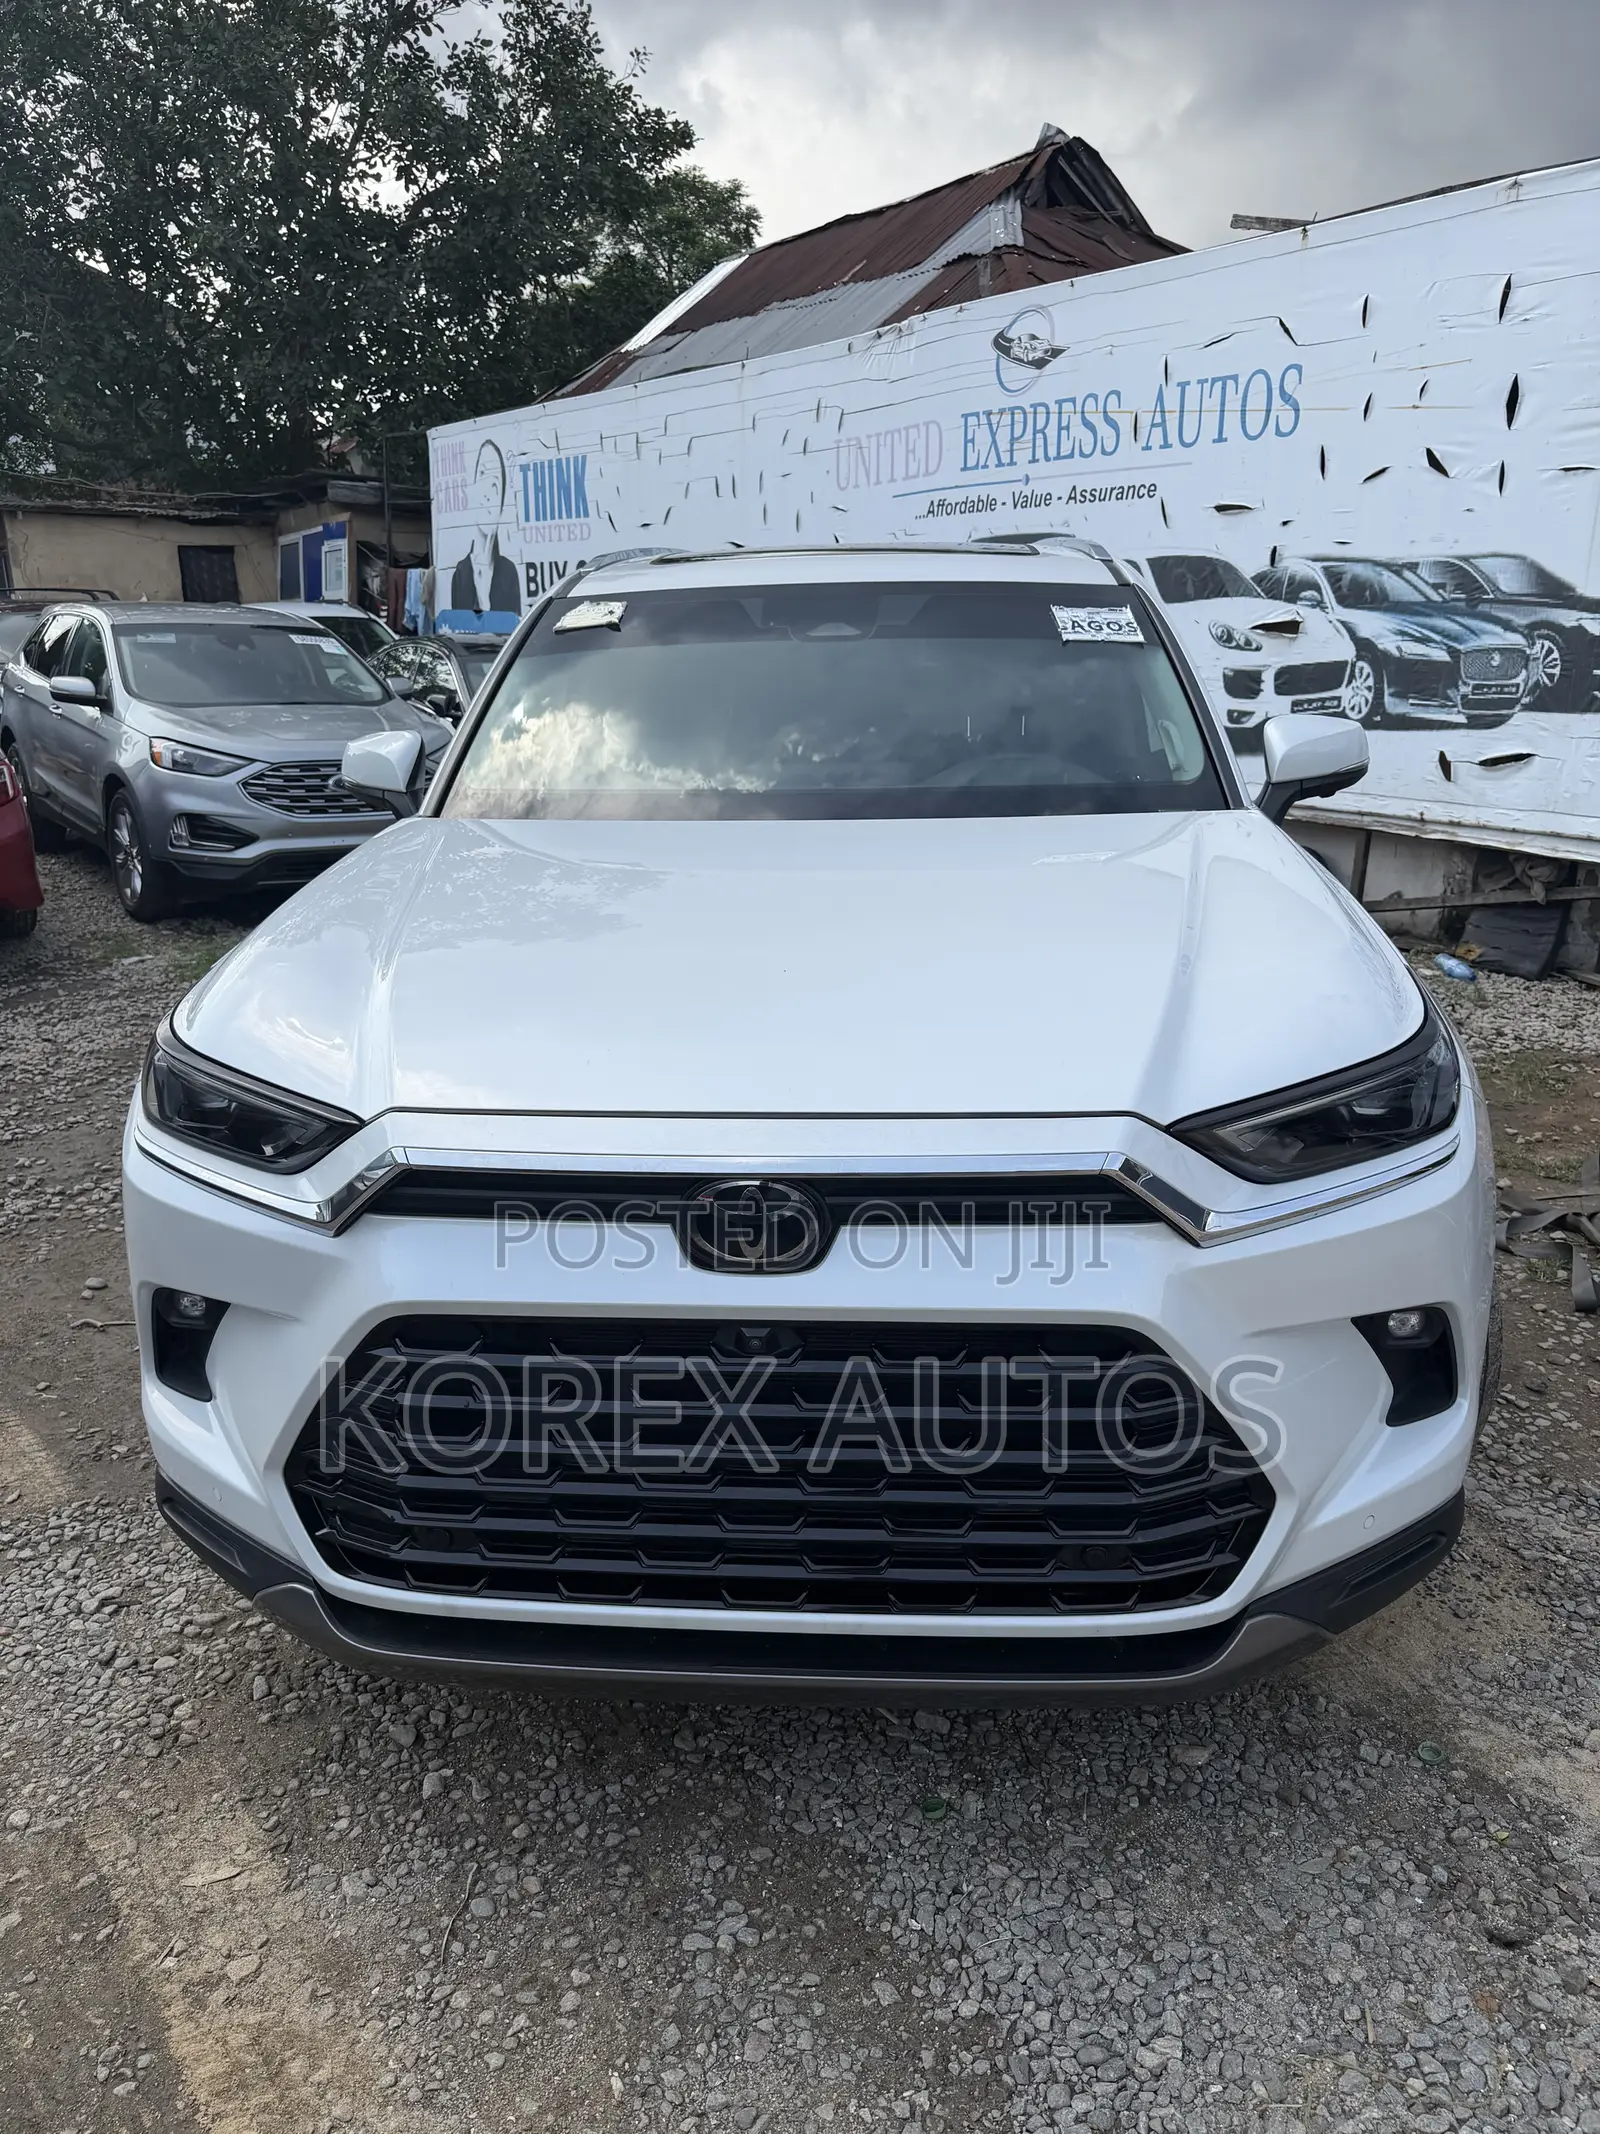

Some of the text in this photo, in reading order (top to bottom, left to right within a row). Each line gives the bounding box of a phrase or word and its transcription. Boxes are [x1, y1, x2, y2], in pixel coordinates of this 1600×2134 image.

[833, 363, 1303, 492] UNITED EXPRESS AUTOS
[434, 441, 467, 479] THINK
[435, 478, 469, 515] CARS
[519, 454, 590, 523] THINK
[1012, 489, 1053, 510] Value
[1066, 482, 1158, 505] Assurance
[522, 522, 592, 544] UNITED
